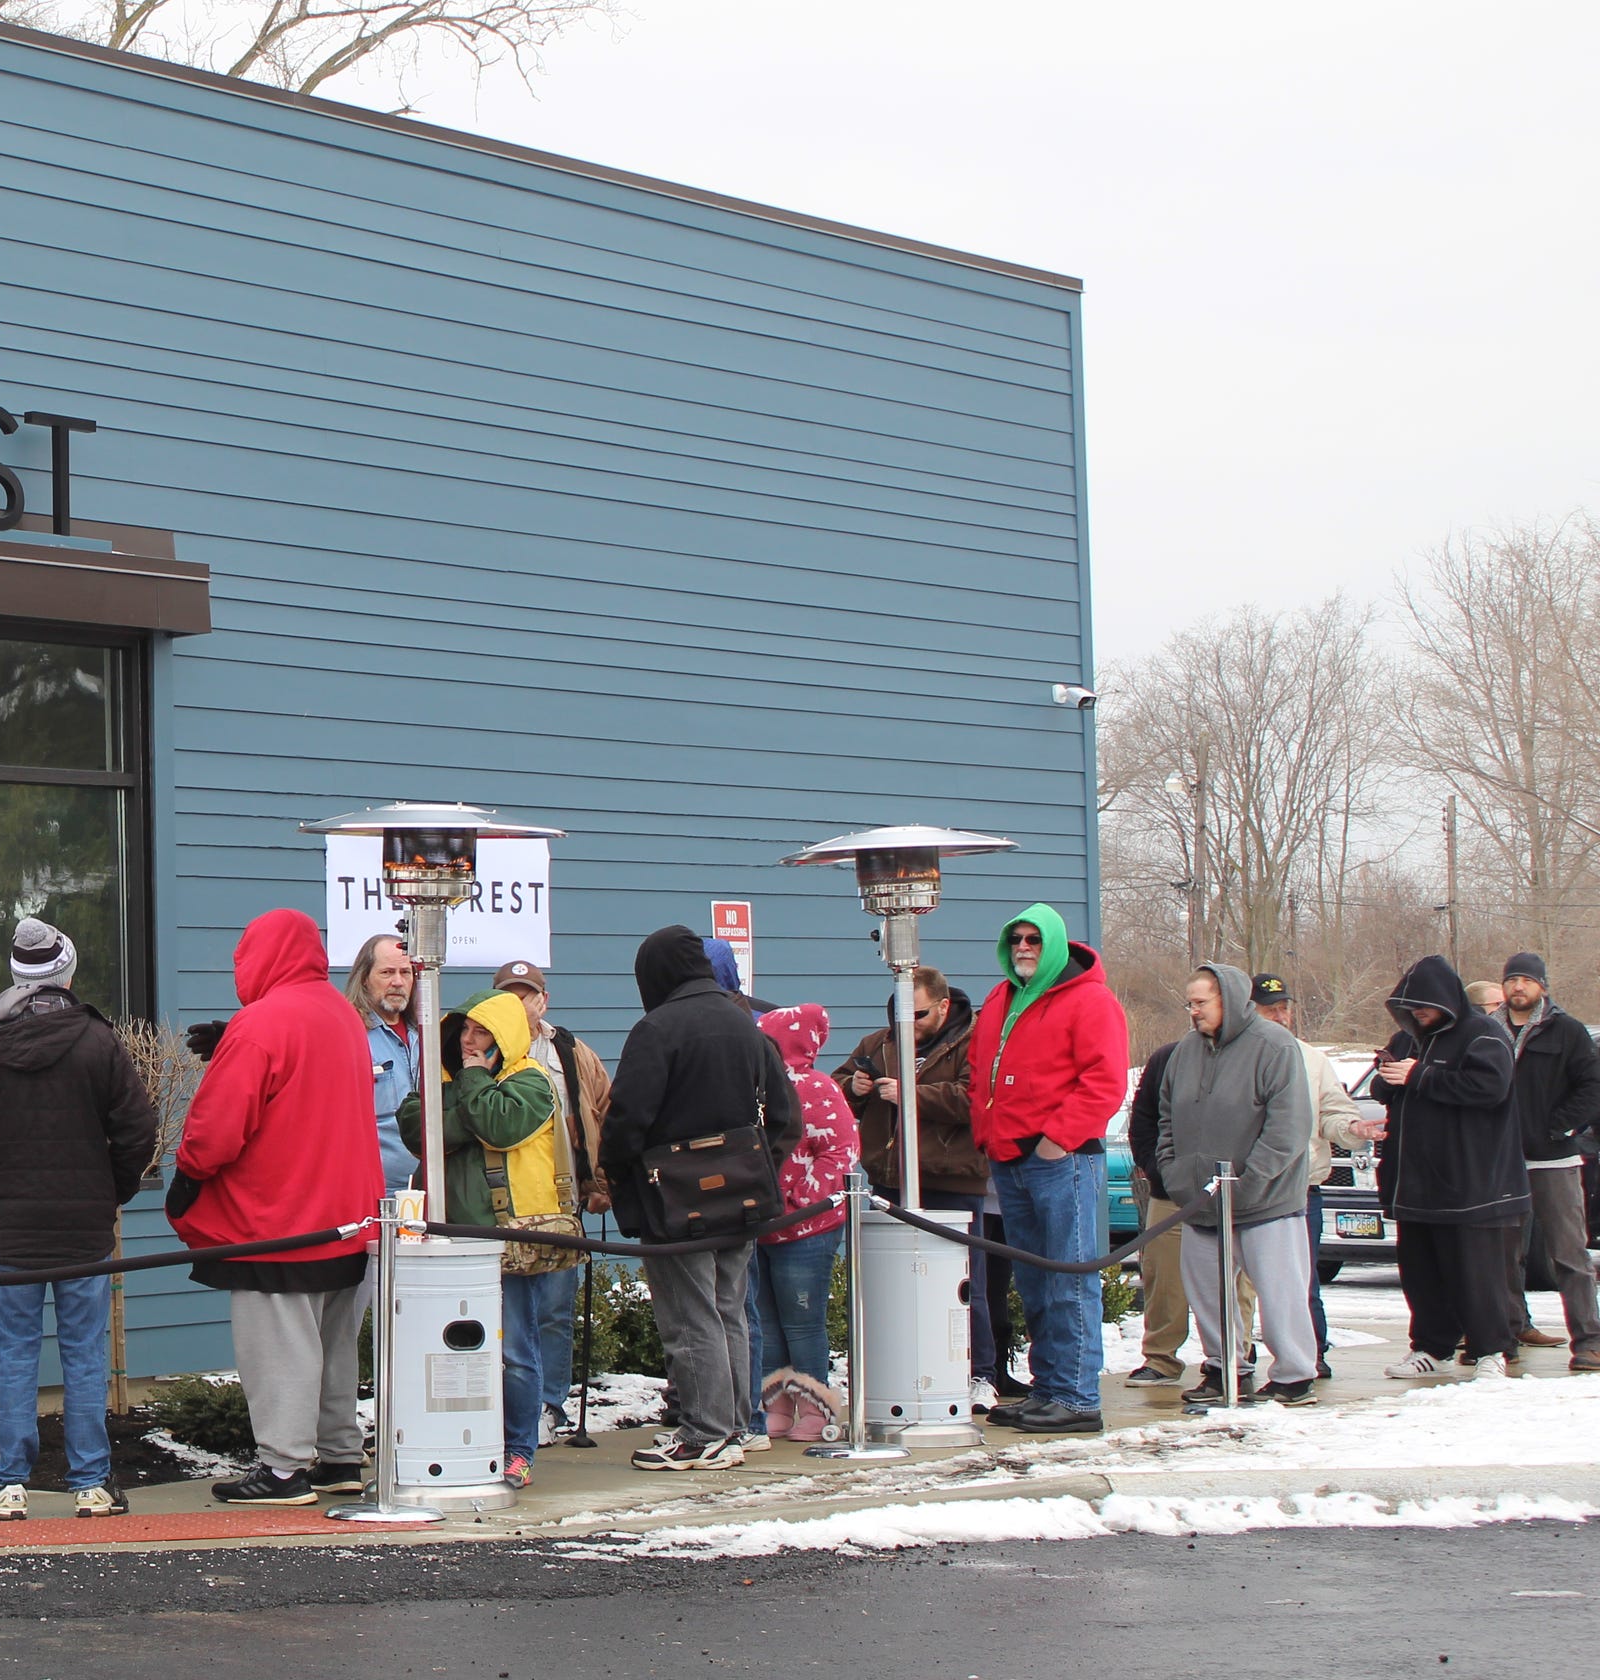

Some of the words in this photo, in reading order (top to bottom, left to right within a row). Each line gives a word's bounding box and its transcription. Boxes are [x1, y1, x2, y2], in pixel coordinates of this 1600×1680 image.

[725, 909, 738, 926] NO
[716, 927, 748, 937] TRESPASSING
[451, 936, 478, 945] OPEN!
